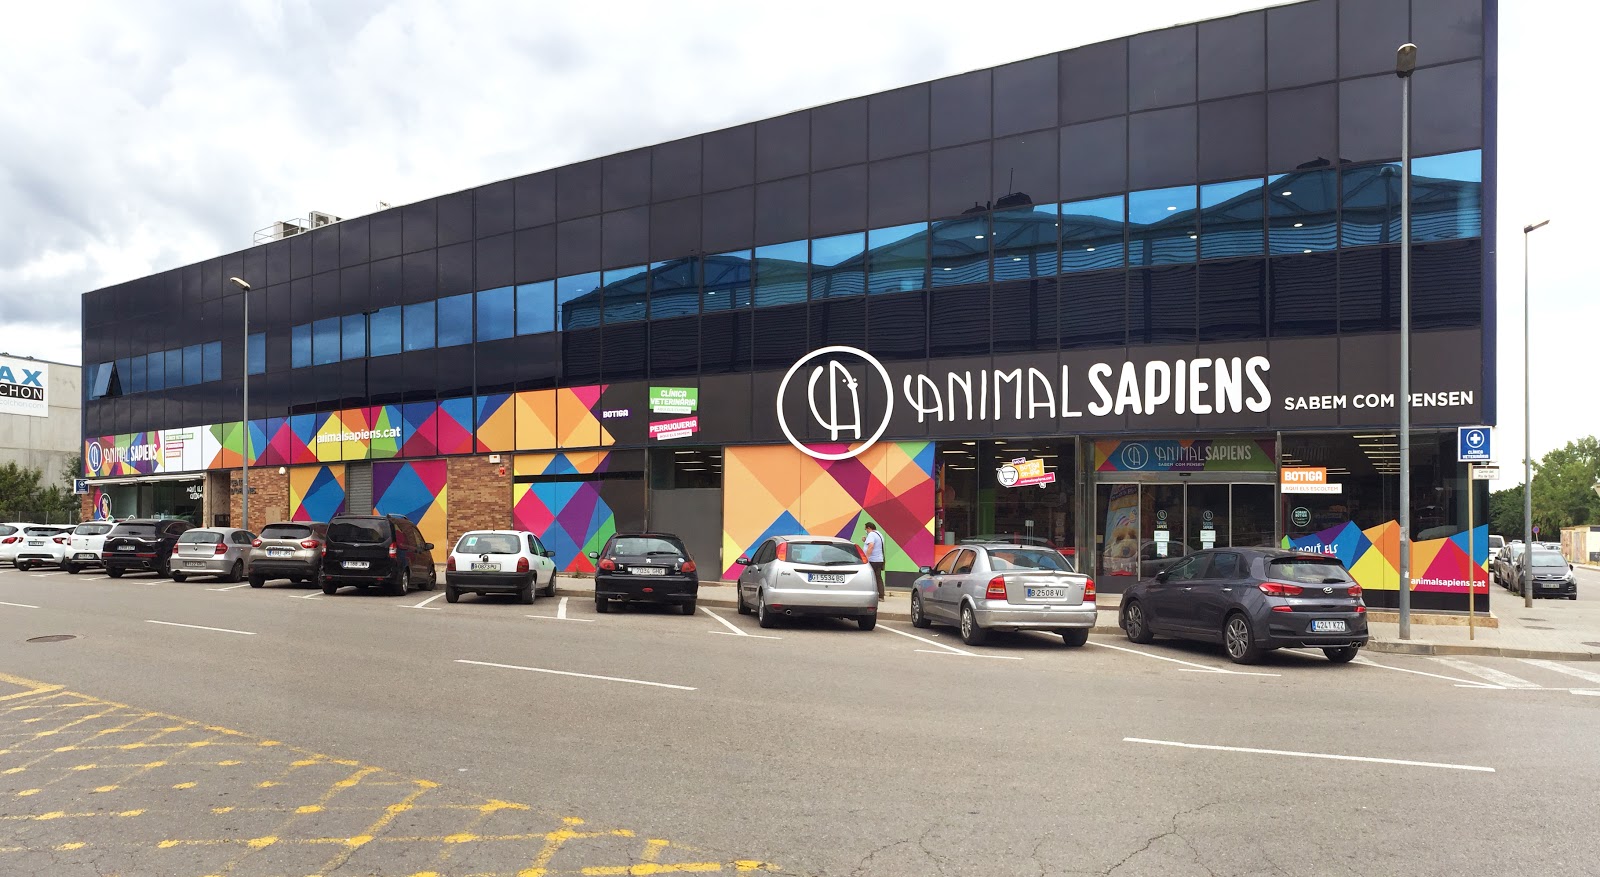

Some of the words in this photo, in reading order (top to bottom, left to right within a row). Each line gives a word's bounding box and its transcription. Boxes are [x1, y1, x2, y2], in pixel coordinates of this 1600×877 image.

[903, 364, 1082, 423] ANIMAL
[1087, 356, 1271, 416] SAPIENS
[1284, 395, 1347, 411] SABEM
[1352, 393, 1395, 408] COM
[603, 409, 629, 418] BOTIGA
[650, 420, 697, 432] PERRUQUERIA
[1155, 446, 1204, 461] ANIMAL
[1205, 445, 1252, 460] SAPIENS
[1284, 471, 1323, 482] BOTIGA
[1324, 544, 1339, 554] ELS
[1411, 578, 1486, 587] animalsapienscat
[1316, 621, 1332, 630] 4241
